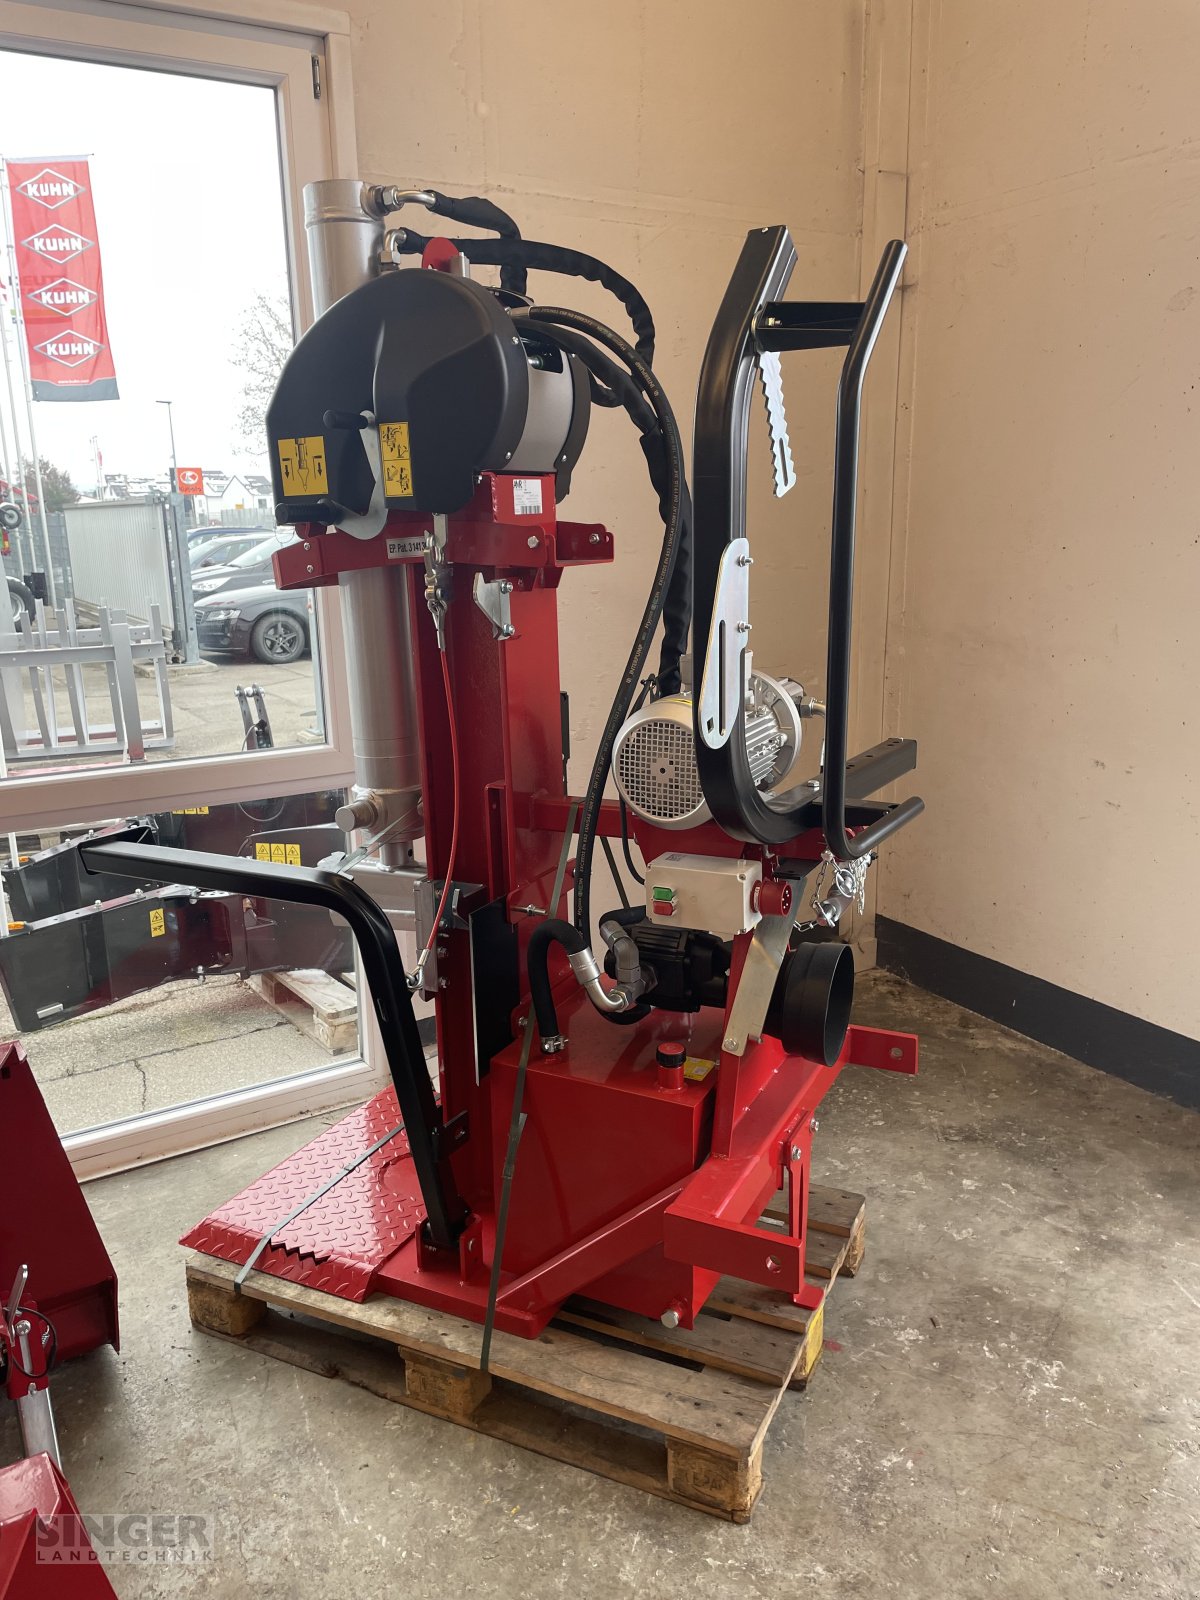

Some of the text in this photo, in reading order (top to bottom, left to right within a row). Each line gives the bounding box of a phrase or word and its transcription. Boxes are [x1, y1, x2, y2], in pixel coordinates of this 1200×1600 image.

[26, 183, 75, 196] KUHN
[33, 238, 82, 251] KUHN
[41, 290, 90, 304] KUHN
[46, 343, 94, 356] KUHN
[398, 543, 408, 552] Pat.
